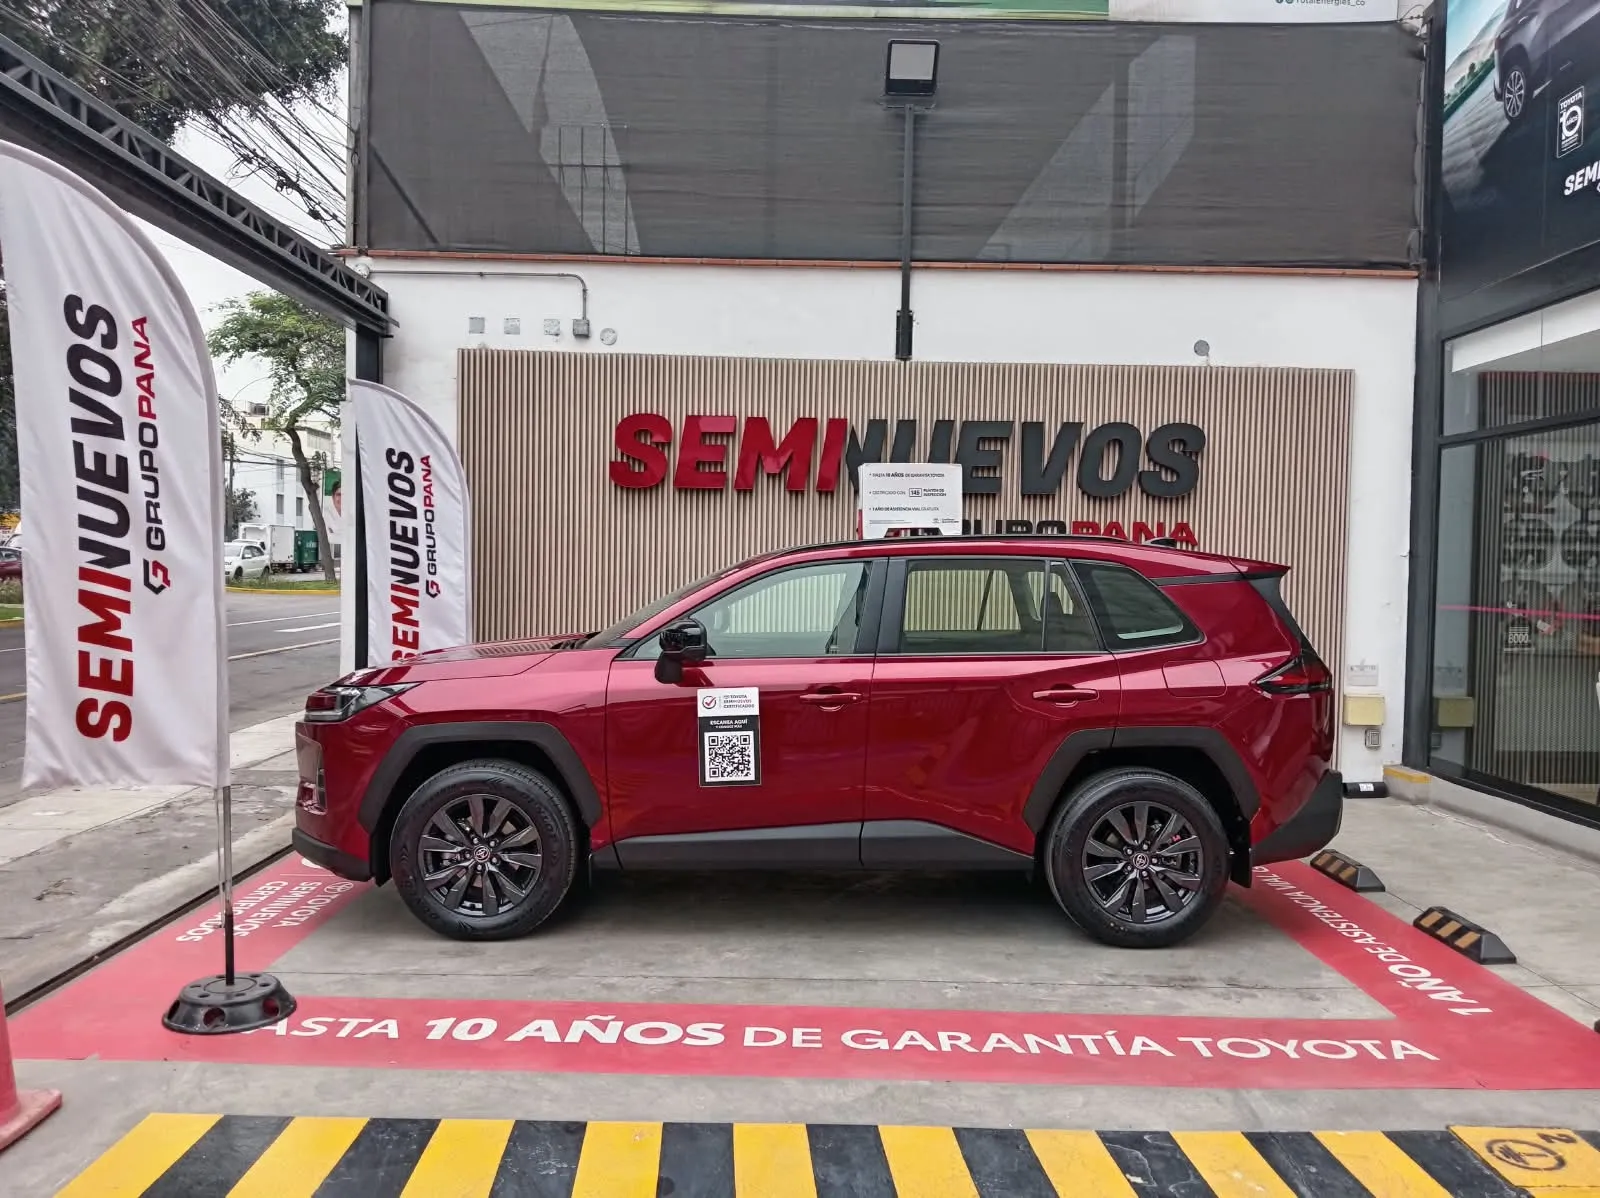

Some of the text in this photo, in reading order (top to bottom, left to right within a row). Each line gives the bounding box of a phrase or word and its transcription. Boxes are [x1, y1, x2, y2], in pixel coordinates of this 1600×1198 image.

[1560, 91, 1583, 110] TOYOTA
[609, 412, 1207, 499] SEMINUEVOS
[63, 293, 134, 743] SEMINUEVOS
[233, 881, 323, 937] SEMINUEVOS
[272, 893, 339, 928] TOYOTA
[1282, 890, 1387, 946] ASISTENCIA
[1363, 946, 1408, 965] DE
[1388, 964, 1480, 1005] AÑO
[241, 1014, 1441, 1061] ASTA 10 AÑOS DE GARANTÍA TOYOTA
